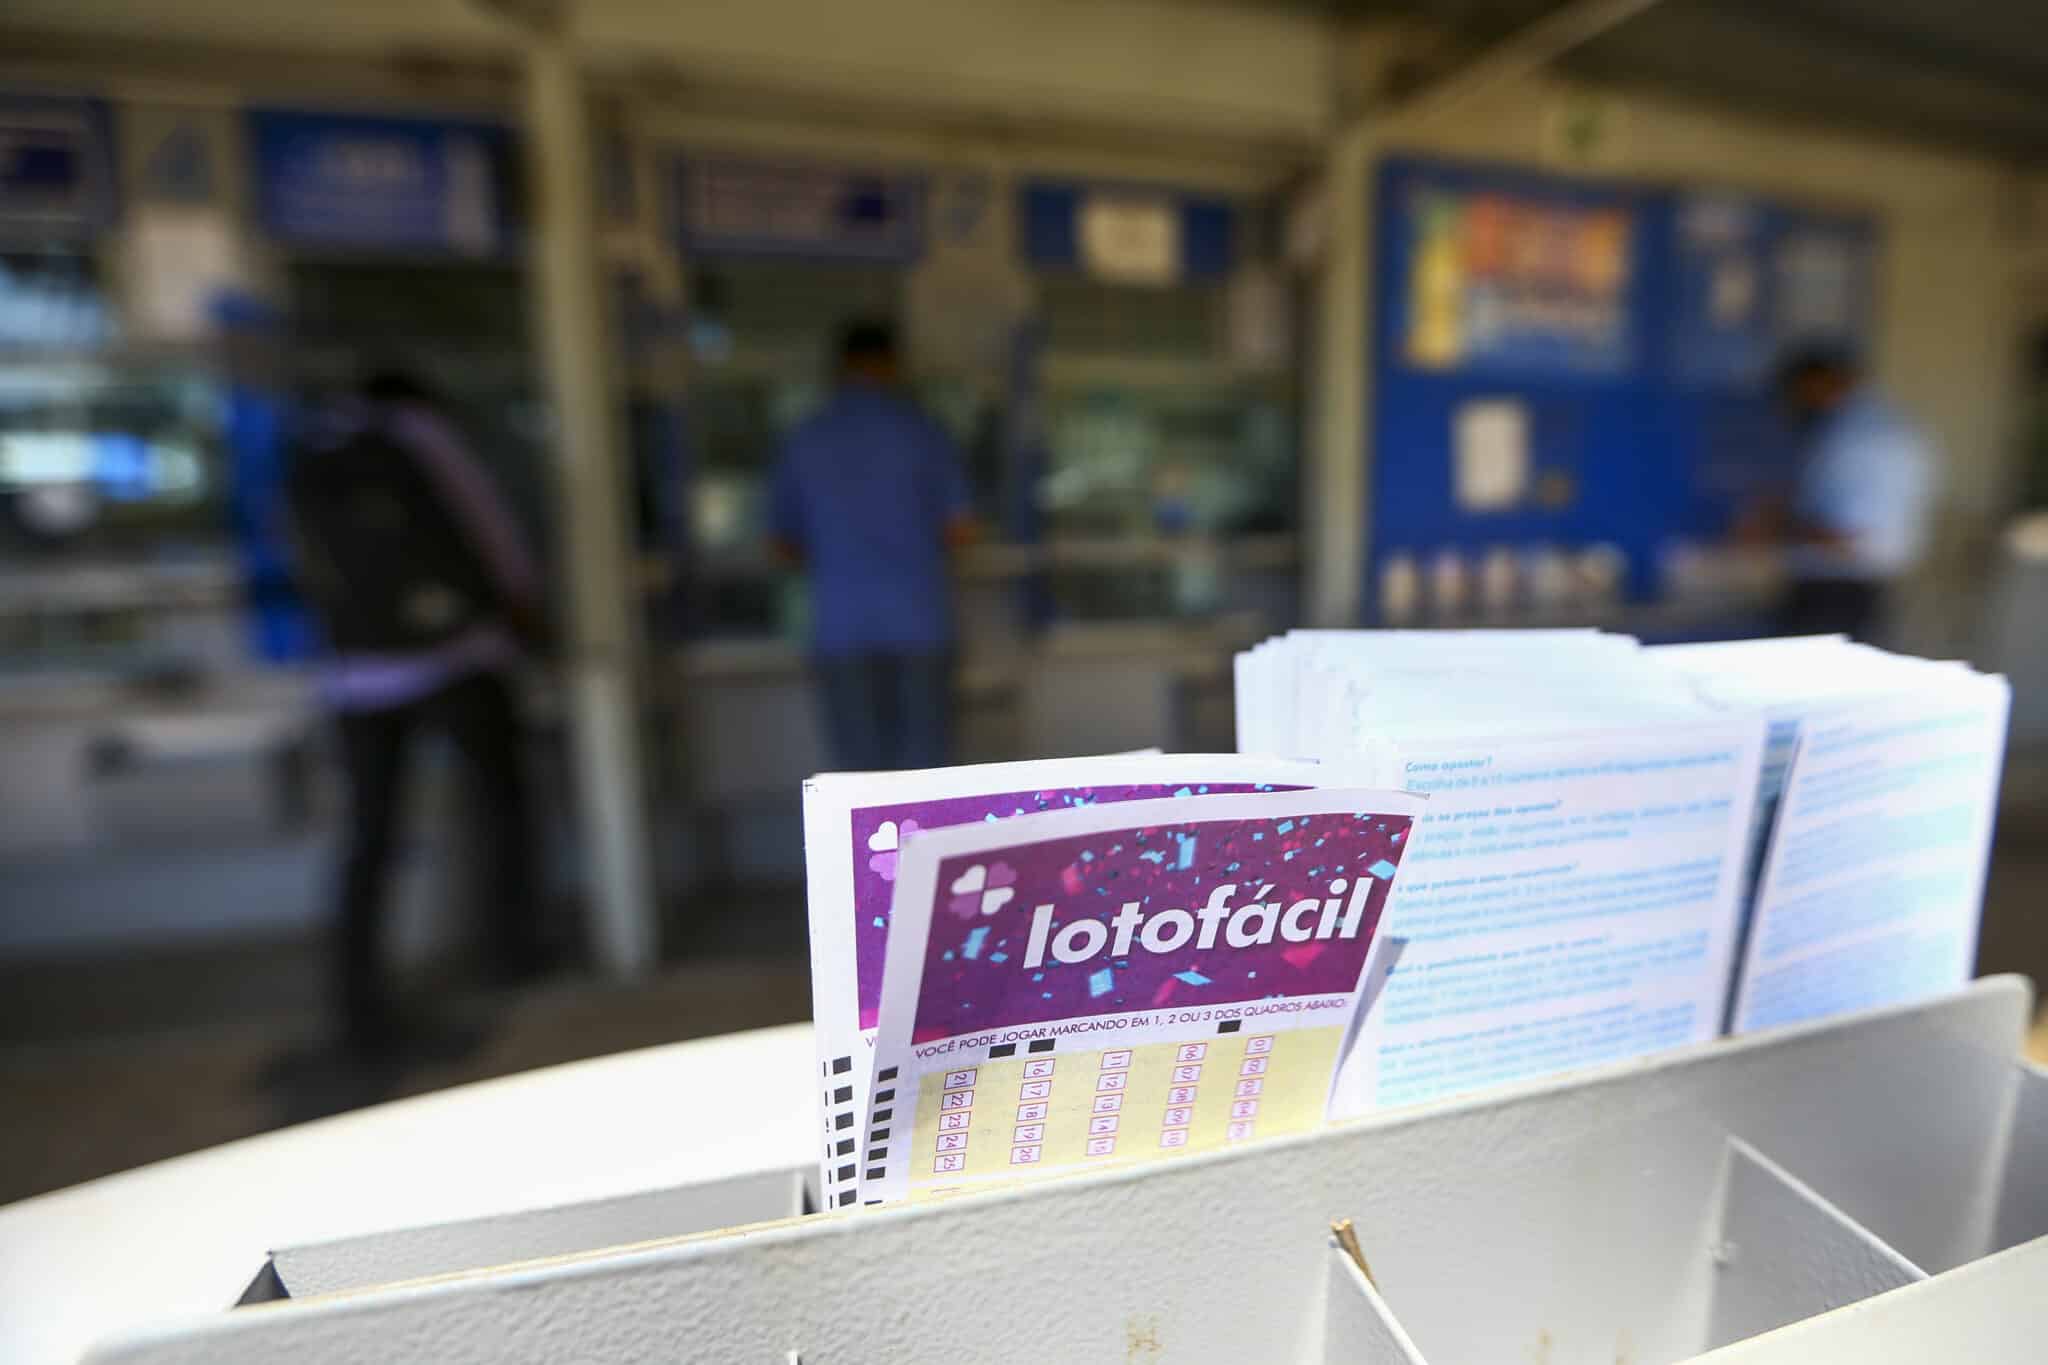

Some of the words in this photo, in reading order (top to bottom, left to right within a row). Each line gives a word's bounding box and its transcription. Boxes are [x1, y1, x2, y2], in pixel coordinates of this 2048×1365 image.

[1023, 876, 1375, 970] lotofácil
[915, 1038, 956, 1059] VOCÊ
[959, 1034, 999, 1048] PODE
[1000, 1027, 1047, 1044] JOGAR
[1050, 1018, 1128, 1036] MARCANDO
[1130, 1016, 1150, 1028] EM
[1154, 1015, 1164, 1027] 1,
[1167, 1013, 1177, 1025] 2
[1179, 1011, 1202, 1023] OU
[1203, 1010, 1212, 1021] 3
[1214, 1007, 1241, 1020] DOS
[1244, 1001, 1301, 1017] QUADROS
